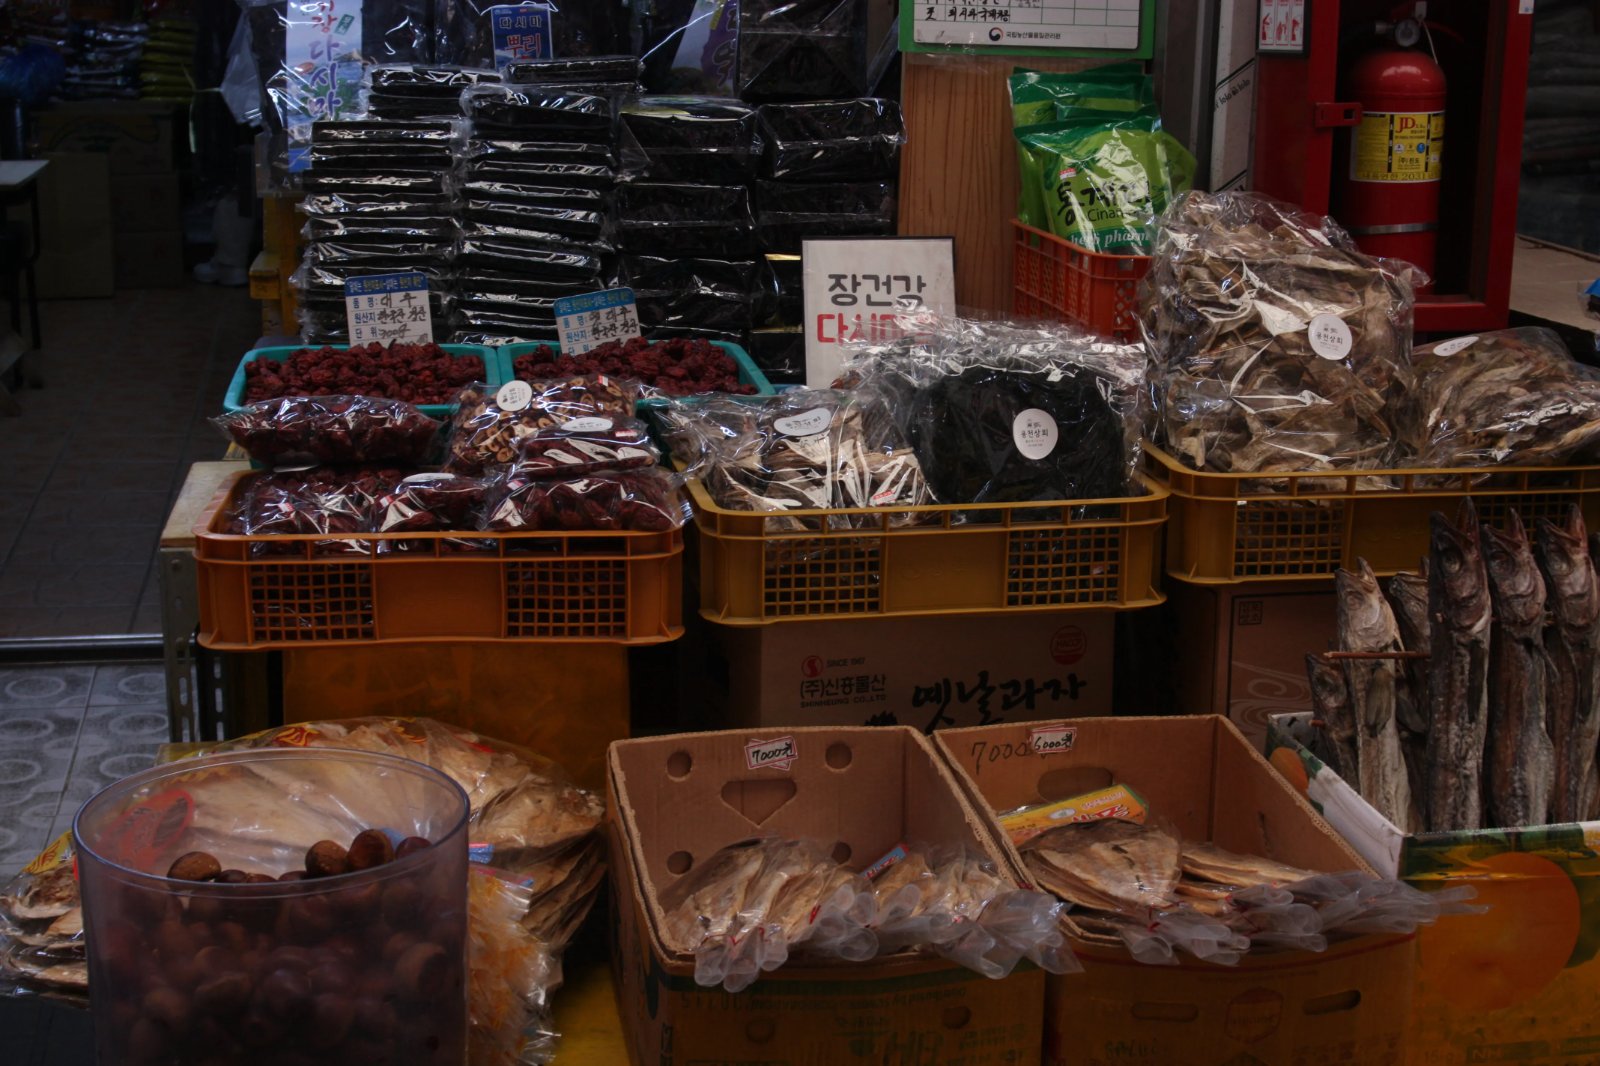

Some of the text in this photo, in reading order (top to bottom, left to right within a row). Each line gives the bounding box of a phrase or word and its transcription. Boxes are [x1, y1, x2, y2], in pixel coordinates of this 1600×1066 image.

[500, 15, 542, 29] 다시마
[505, 33, 542, 58] 뿌리
[1396, 117, 1416, 133] JD
[827, 274, 927, 307] 장건강
[355, 312, 376, 324] 원산지
[800, 674, 887, 699] (주)신흥물산
